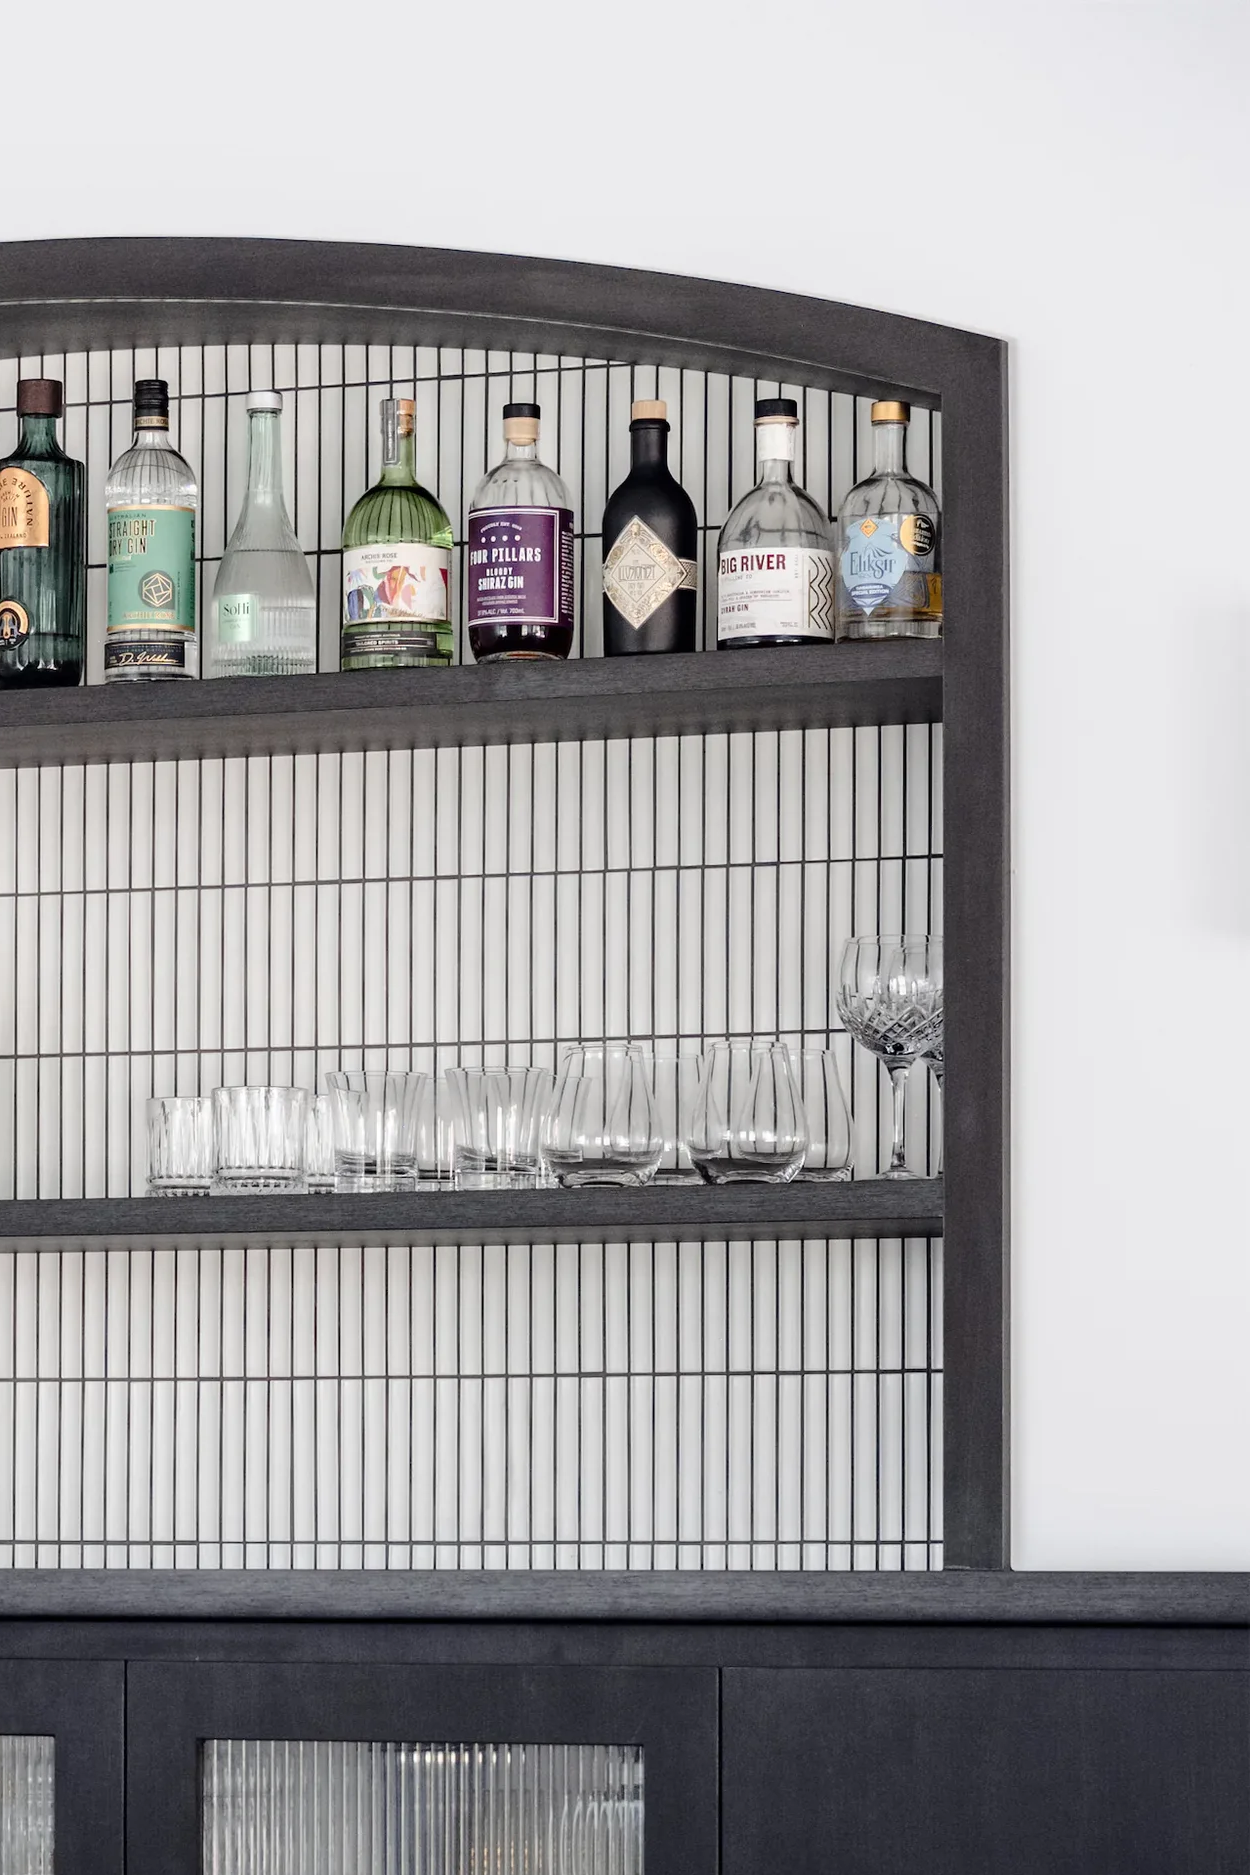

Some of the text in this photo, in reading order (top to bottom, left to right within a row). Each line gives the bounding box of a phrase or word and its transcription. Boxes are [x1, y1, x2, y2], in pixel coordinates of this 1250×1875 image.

[2, 506, 18, 527] GIN
[111, 512, 147, 520] USTRALIAN
[109, 520, 155, 539] STRAIGHT
[109, 538, 146, 557] DRY GIN
[470, 547, 542, 565] FOUR PILLARS
[486, 567, 513, 576] BLOODY
[721, 554, 786, 575] BIG RIVER
[478, 575, 524, 591] SHIRAZ GIN
